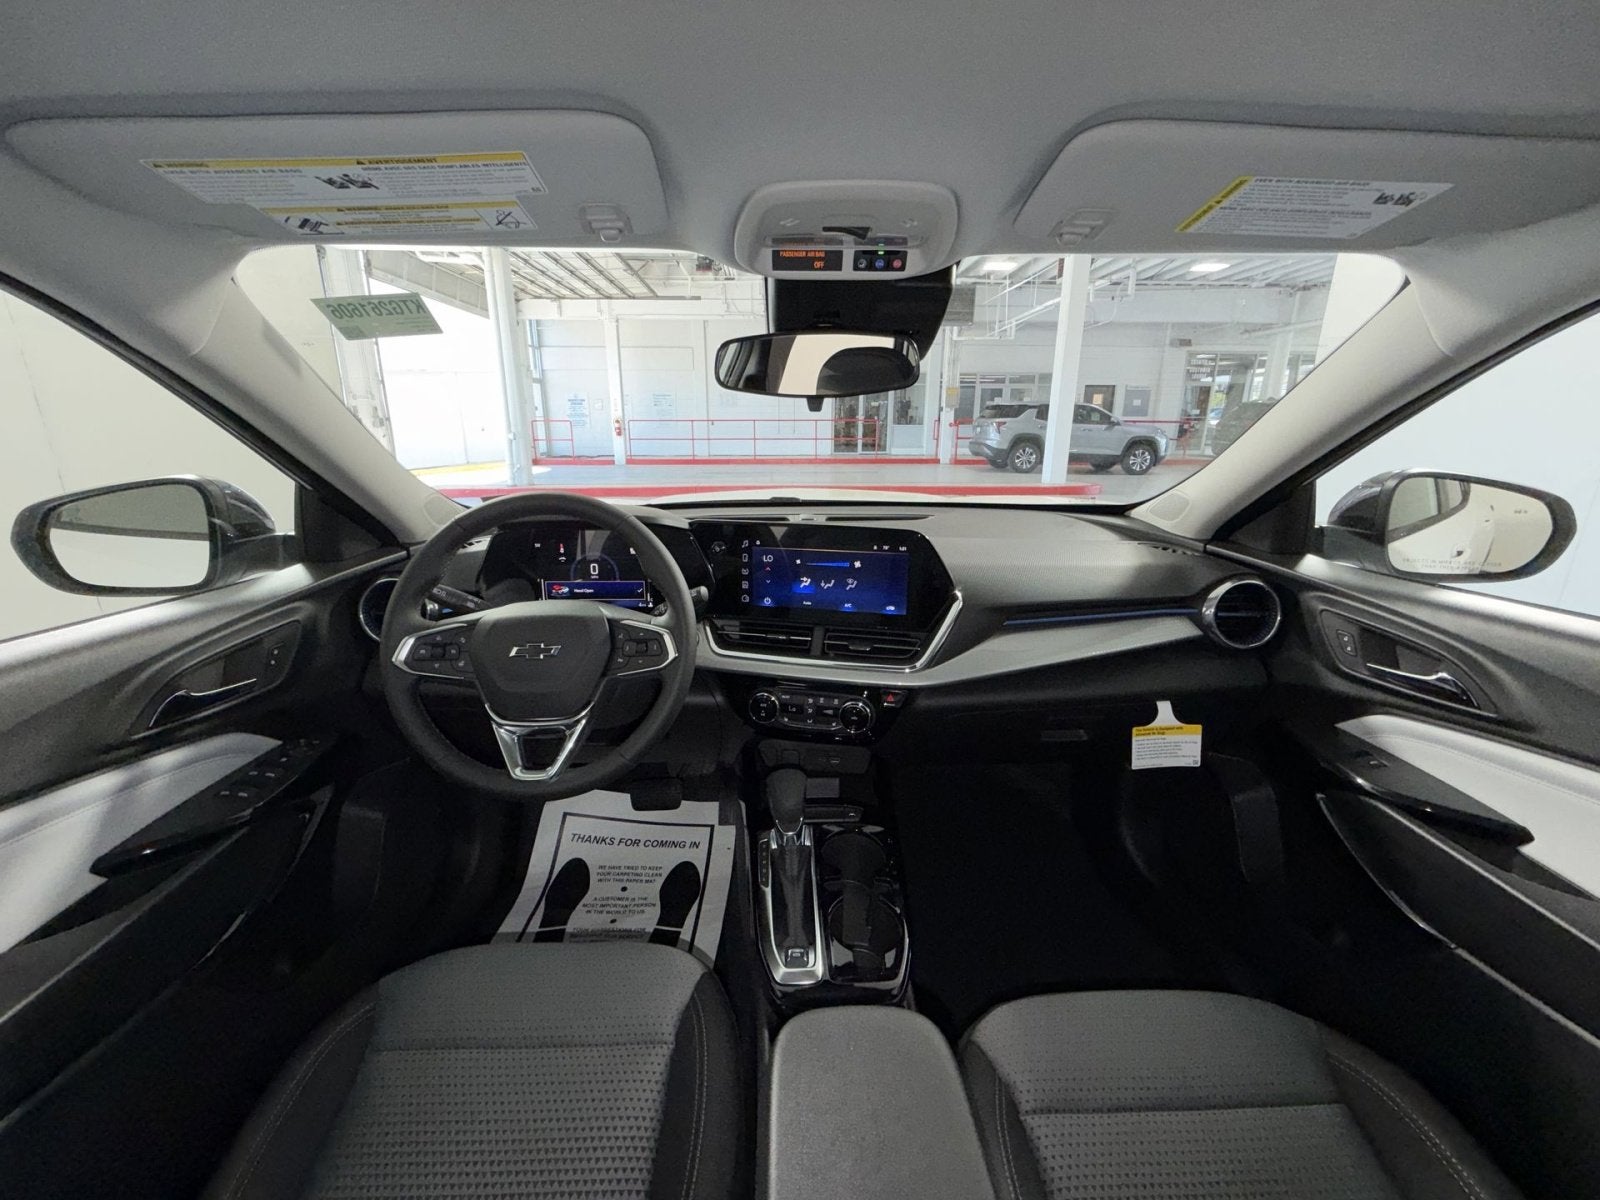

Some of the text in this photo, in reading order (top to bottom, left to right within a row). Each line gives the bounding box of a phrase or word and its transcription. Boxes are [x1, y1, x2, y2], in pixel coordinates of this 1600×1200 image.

[590, 563, 599, 575] 0
[571, 833, 700, 849] THANKS FOR COMING IN
